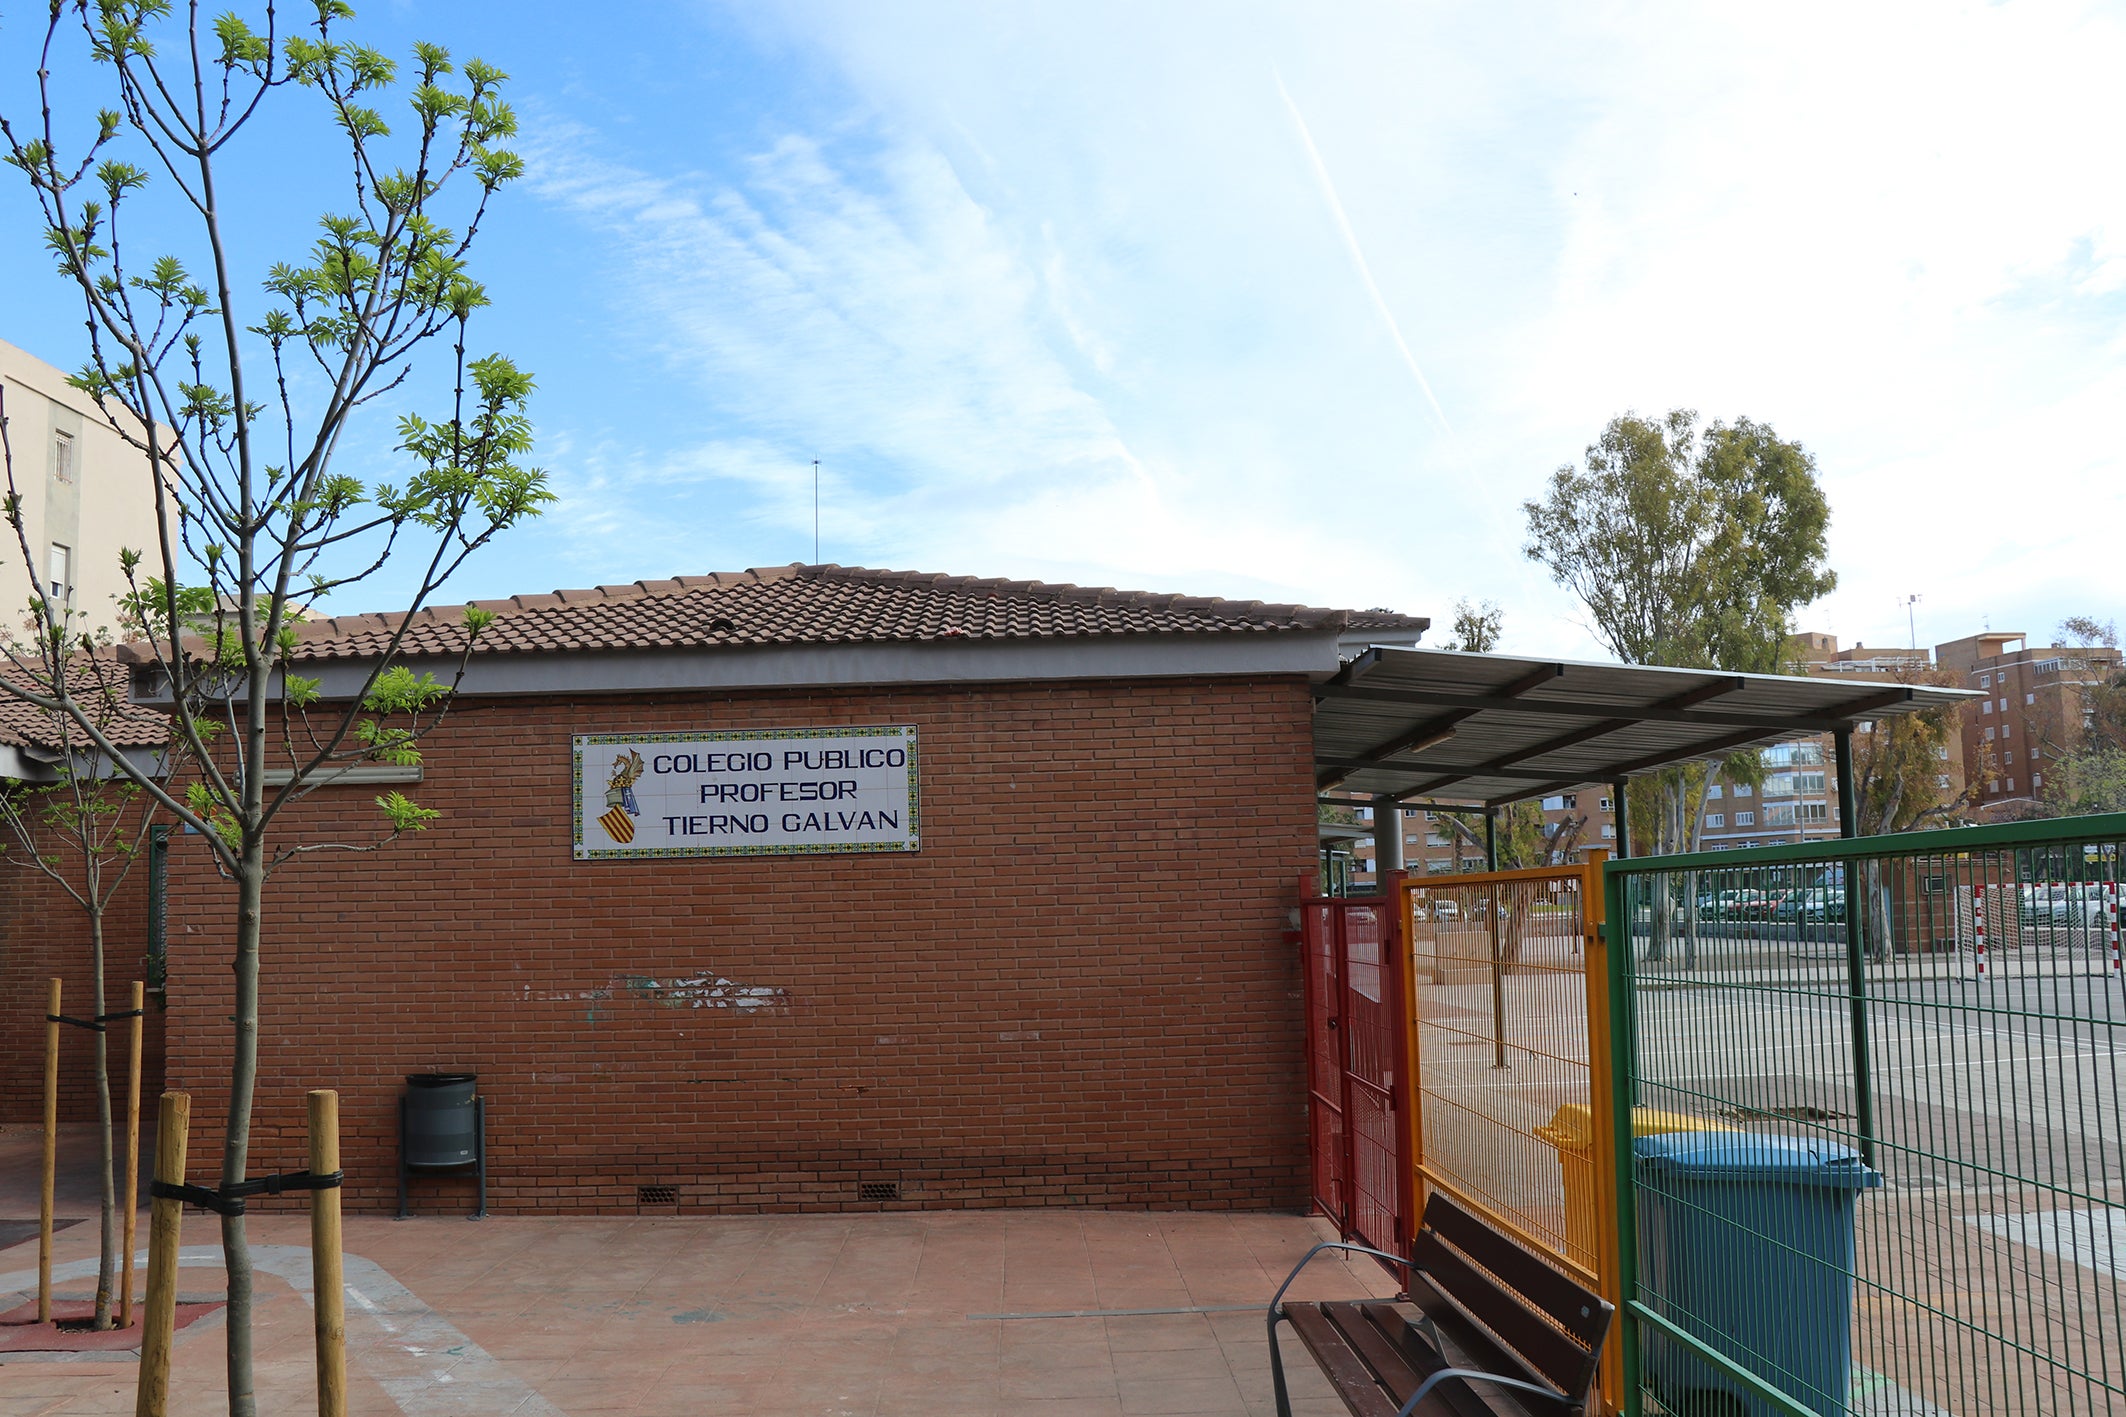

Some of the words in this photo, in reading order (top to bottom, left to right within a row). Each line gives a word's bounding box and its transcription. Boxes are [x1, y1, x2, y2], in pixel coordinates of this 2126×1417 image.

[653, 752, 772, 774] COLEGIO
[784, 748, 905, 770] PUBLICO
[700, 780, 857, 803] PROFESOR
[662, 814, 769, 835] TIERNO
[781, 809, 898, 832] GALVAN
